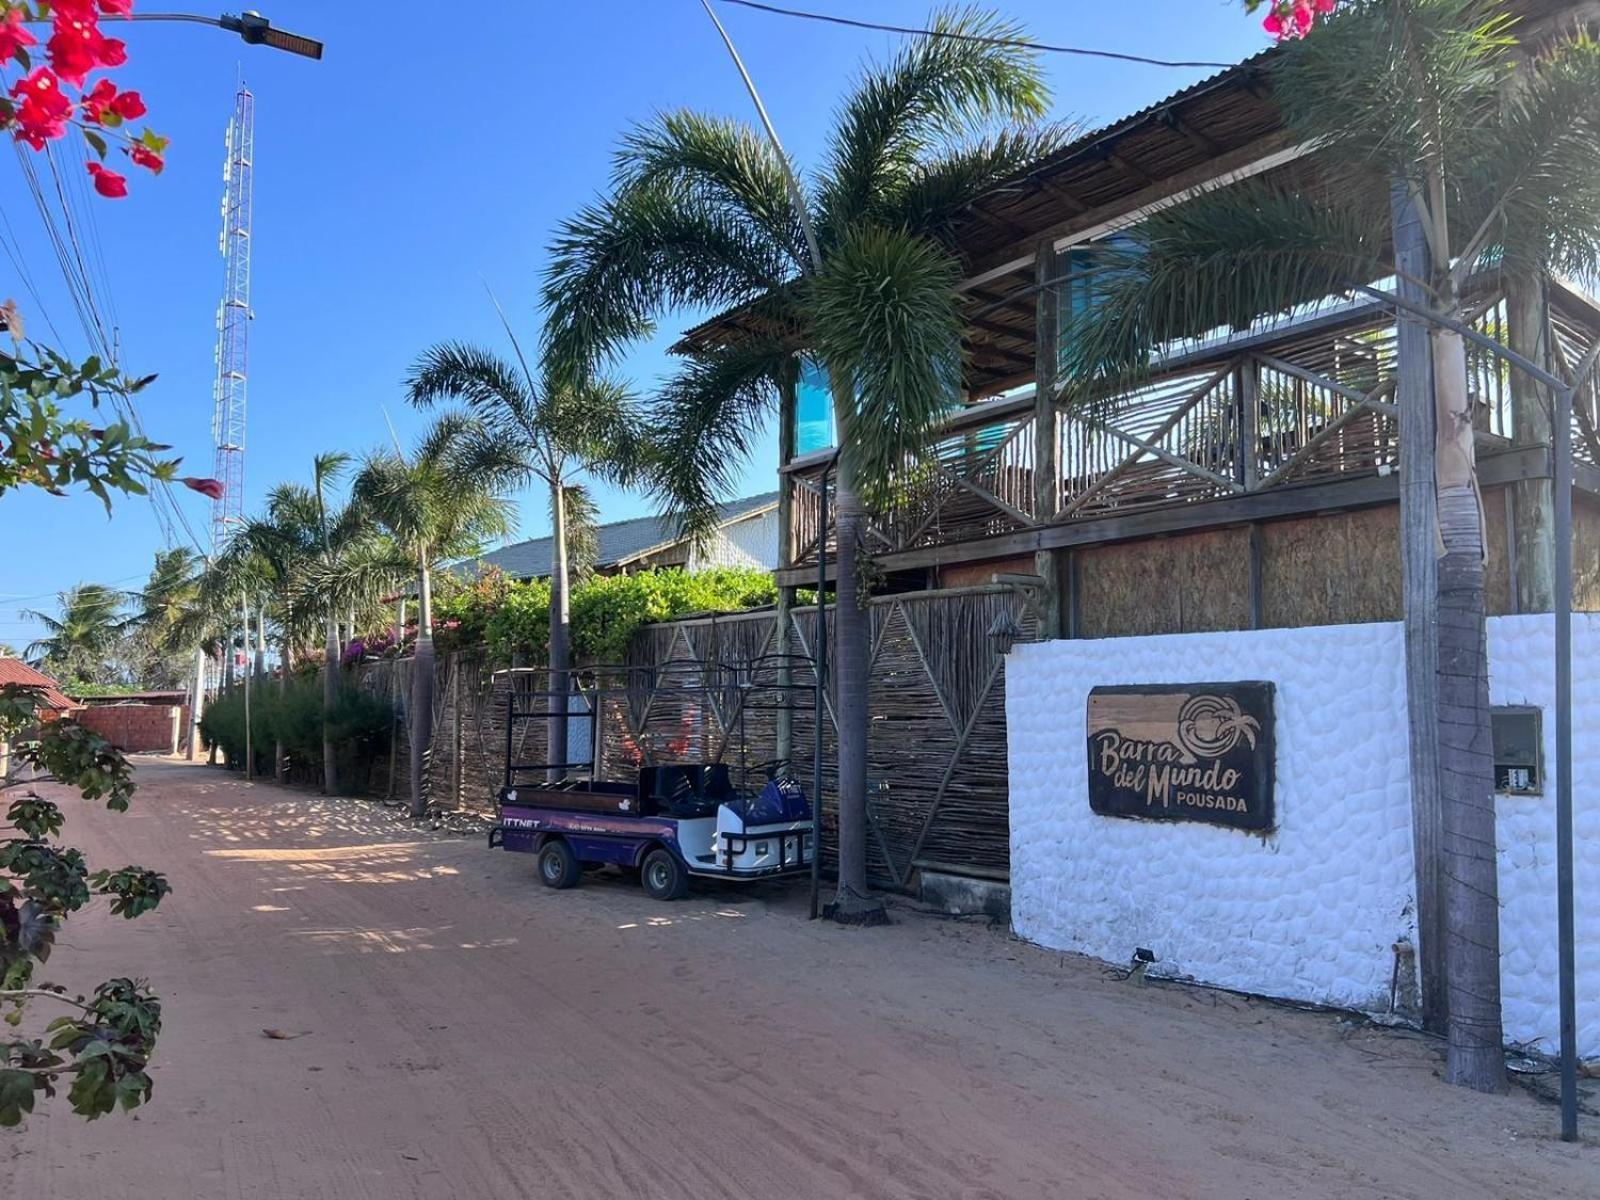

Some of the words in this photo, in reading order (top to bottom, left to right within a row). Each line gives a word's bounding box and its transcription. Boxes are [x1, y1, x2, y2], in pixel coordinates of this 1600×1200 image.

[1096, 732, 1181, 776] Barra
[1114, 763, 1146, 792] del
[1147, 759, 1241, 808] Mundo
[1176, 791, 1248, 813] POUSADA
